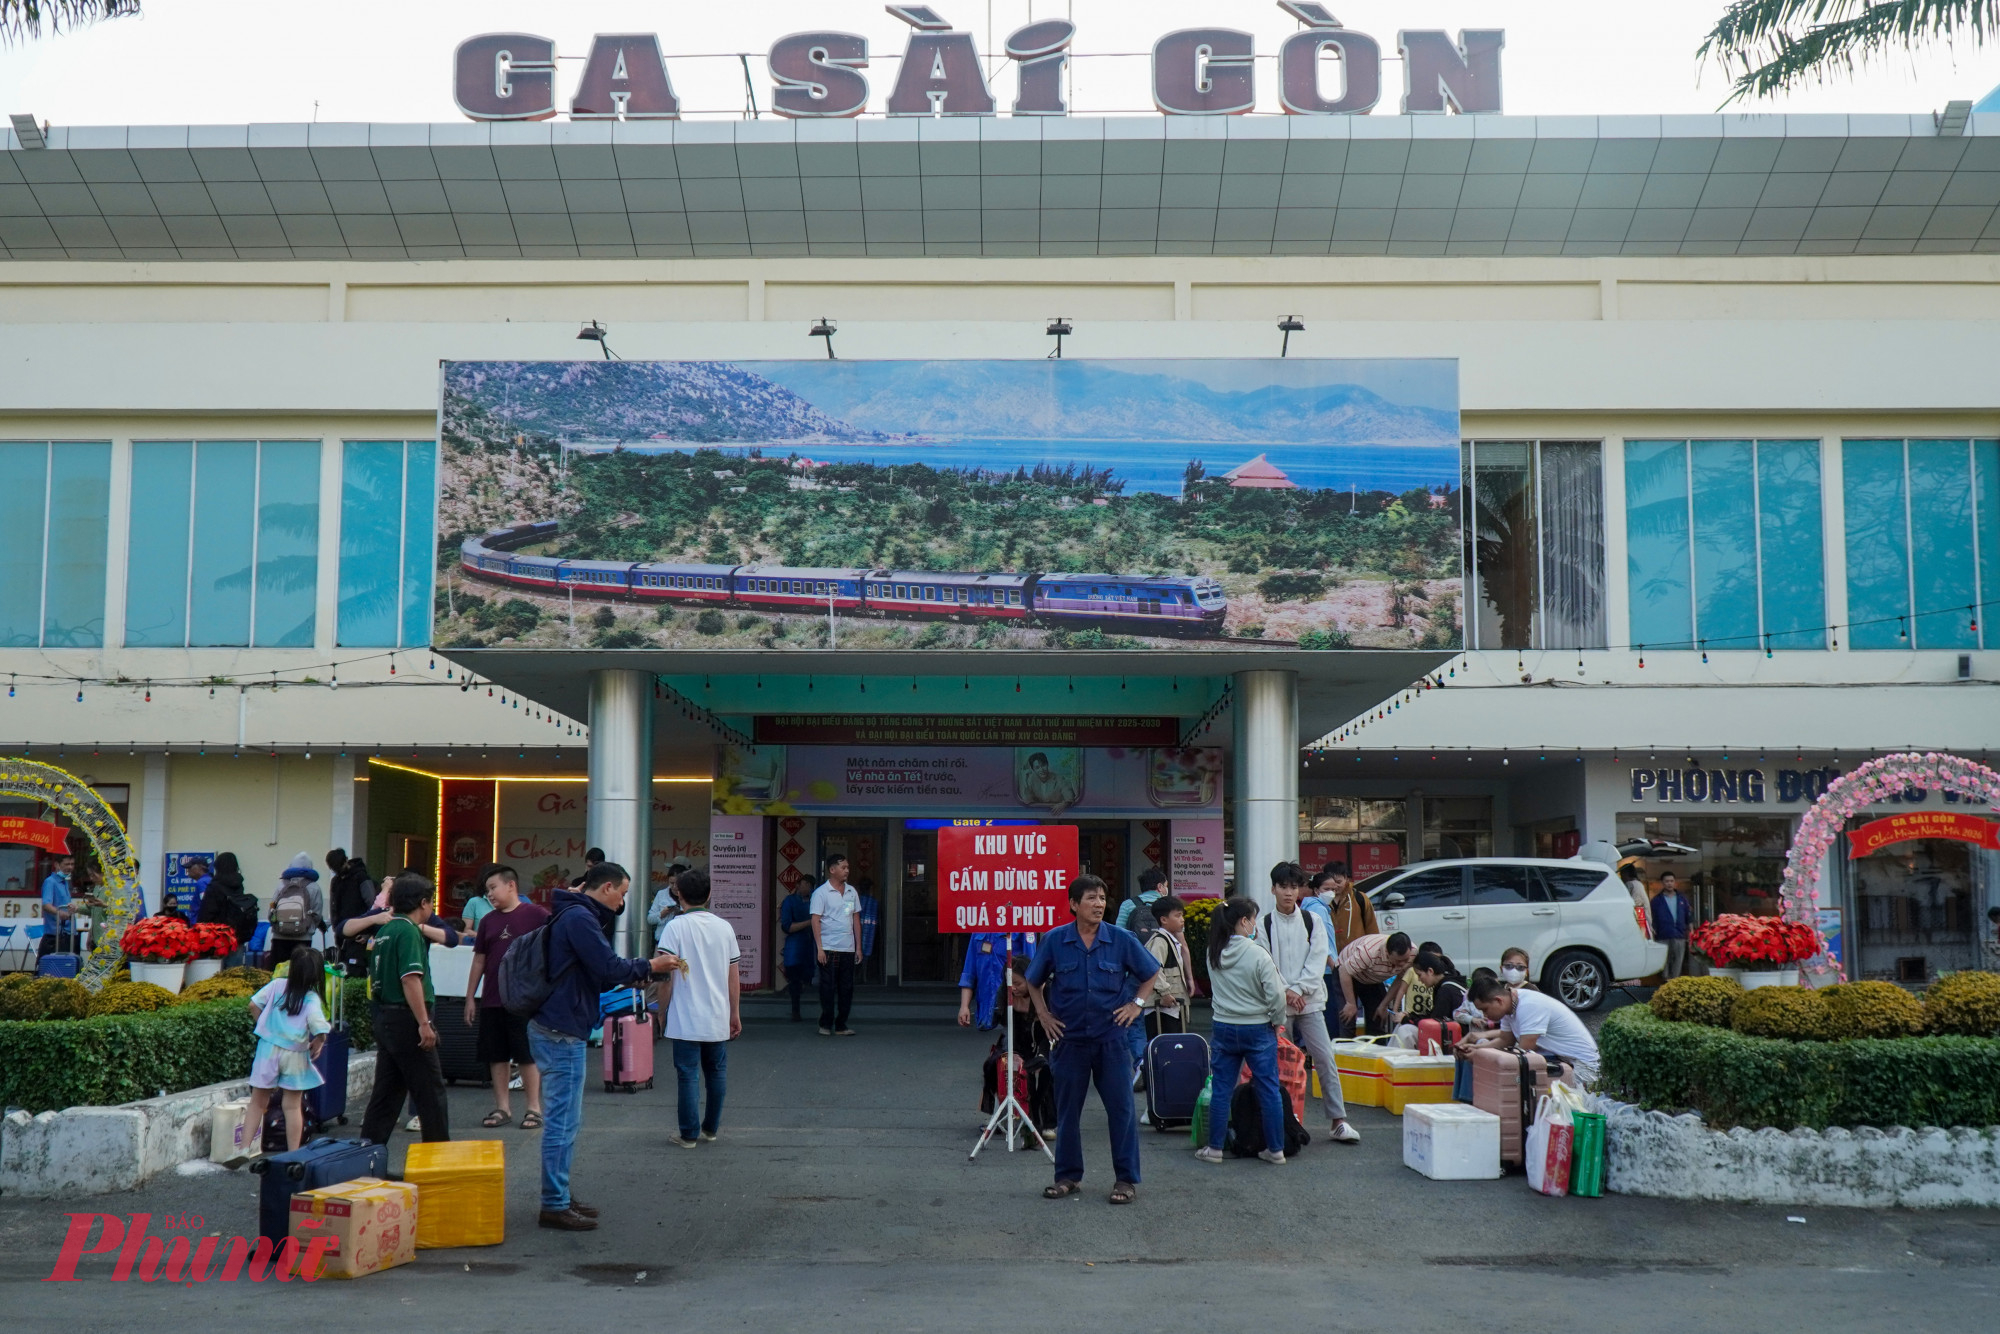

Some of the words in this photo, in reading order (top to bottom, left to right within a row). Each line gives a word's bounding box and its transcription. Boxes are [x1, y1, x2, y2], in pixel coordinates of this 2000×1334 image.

[453, 31, 682, 119] GA
[1152, 0, 1506, 116] GÒN
[902, 716, 922, 727] CÔNG
[926, 718, 935, 727] TY
[984, 717, 1002, 729] VIỆT
[1004, 718, 1022, 728] NAM
[1117, 718, 1161, 728] 2025-2030
[1018, 732, 1031, 740] XIV
[847, 758, 869, 770] Một
[872, 758, 896, 768] năm
[898, 758, 929, 768] chăm
[864, 771, 884, 780] nhà
[887, 772, 901, 780] ăn
[903, 770, 922, 780] Tết
[940, 786, 962, 794] sau.
[537, 792, 577, 814] Ga
[2, 819, 25, 828] GÒN
[1891, 818, 1907, 826] GA
[1909, 814, 1929, 824] SÀI
[1932, 813, 1955, 823] GÒN
[30, 832, 50, 844] 2026
[1867, 831, 1894, 846] Chúc
[1921, 825, 1942, 836] Năm
[1962, 828, 1983, 840] 2026
[505, 834, 562, 860] Chúc
[974, 834, 1007, 855] KHU
[1013, 832, 1047, 860] VỰC
[949, 866, 988, 892] CẤM
[994, 866, 1038, 891] DỪNG
[1044, 869, 1067, 890] XE
[4, 900, 21, 918] ÉP
[956, 902, 990, 930] QUÁ
[996, 906, 1007, 926] 3
[1012, 901, 1056, 926] PHÚT
